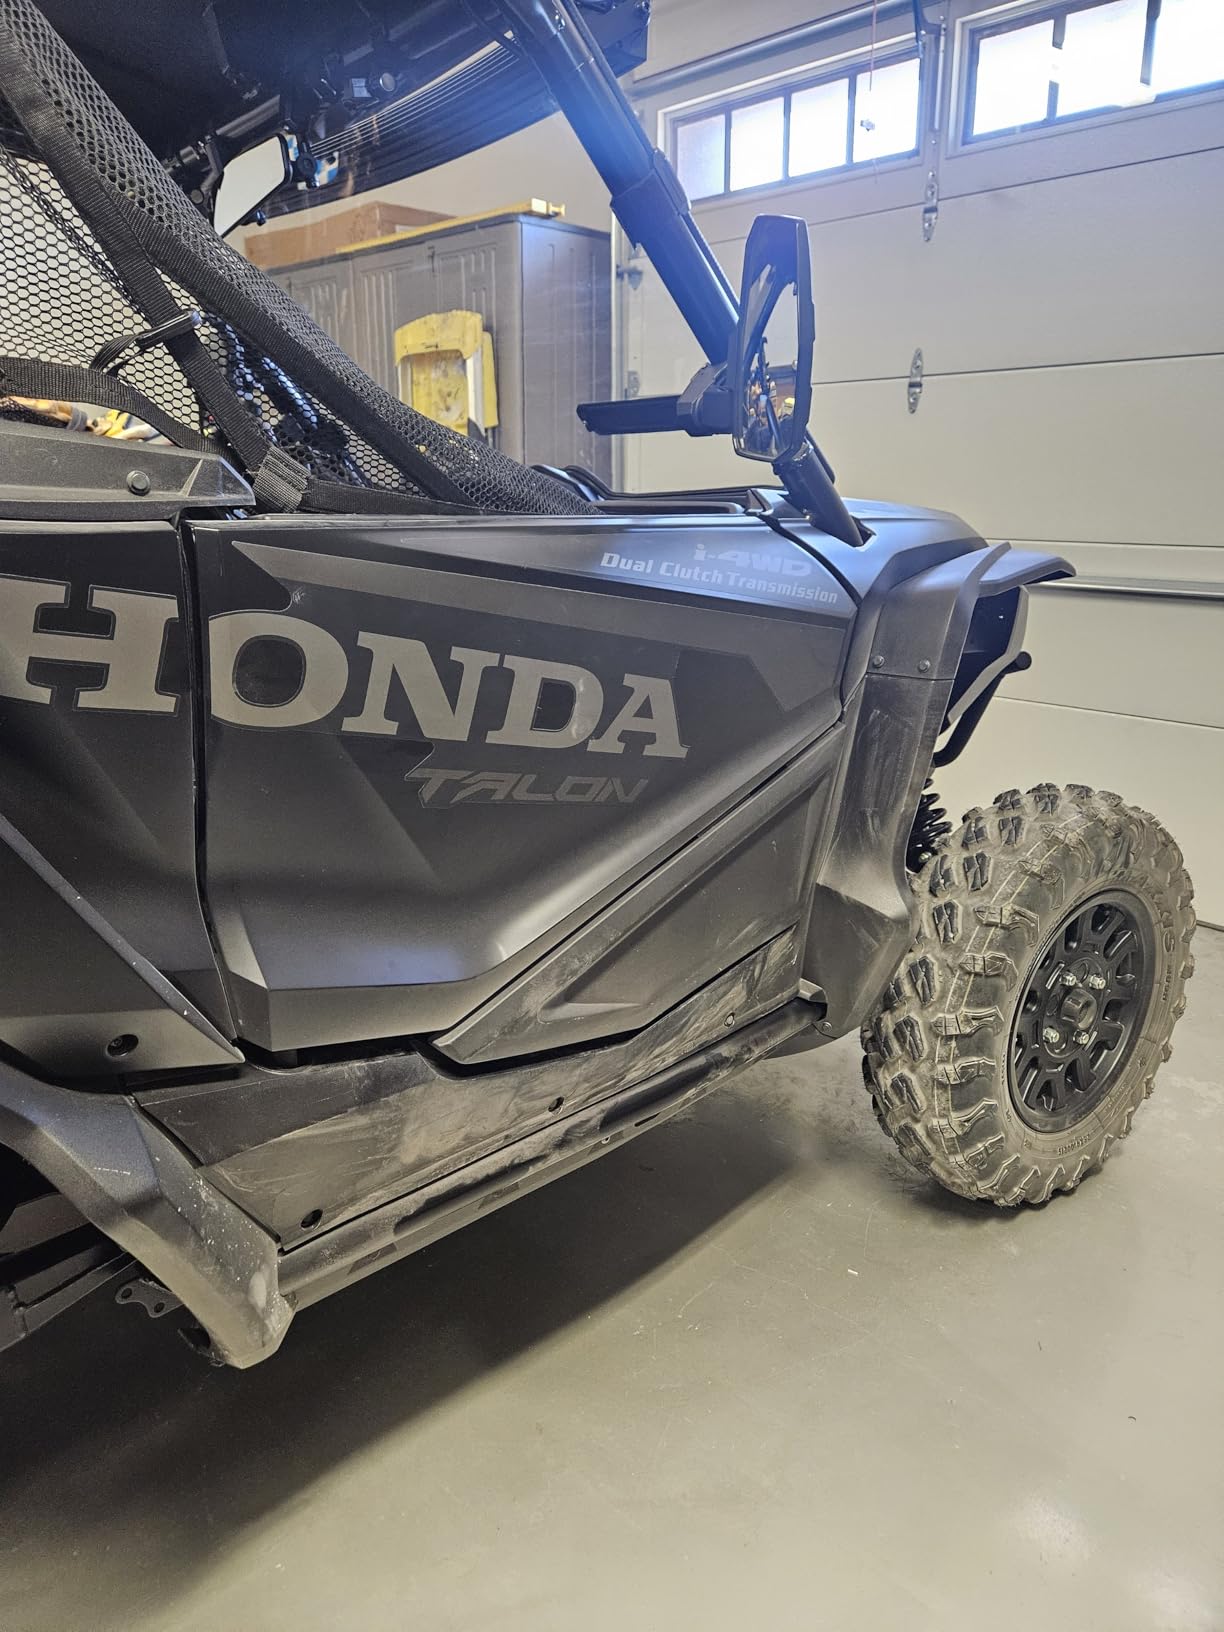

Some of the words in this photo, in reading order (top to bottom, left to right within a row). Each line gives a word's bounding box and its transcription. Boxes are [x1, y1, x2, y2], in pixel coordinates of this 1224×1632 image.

[600, 551, 653, 574] Dual
[660, 562, 723, 585] Clutch
[726, 572, 838, 604] Transmission
[693, 544, 812, 577] i-4WD
[407, 767, 649, 804] TALON
